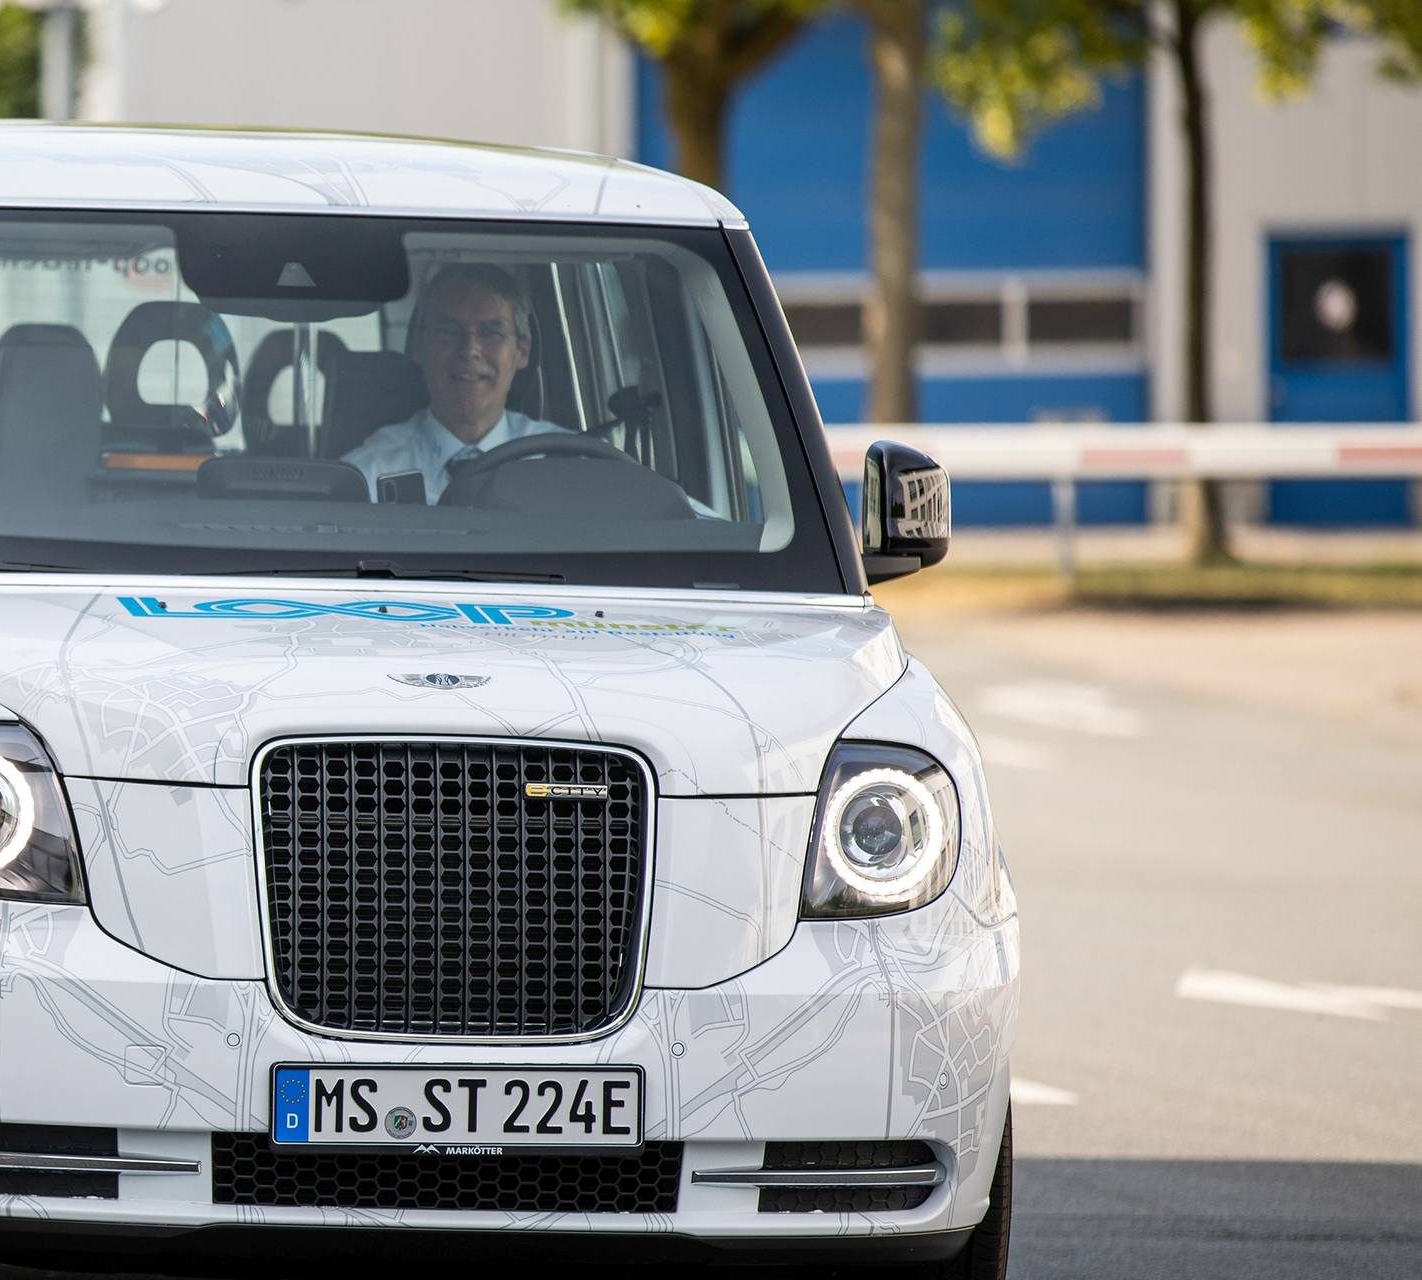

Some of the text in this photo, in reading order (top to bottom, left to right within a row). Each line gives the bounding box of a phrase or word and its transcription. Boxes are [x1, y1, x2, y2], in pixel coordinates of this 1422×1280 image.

[116, 596, 575, 625] LOOP
[287, 1113, 298, 1129] D
[314, 1078, 378, 1133] MS
[422, 1078, 487, 1133] ST
[503, 1079, 631, 1135] 224E
